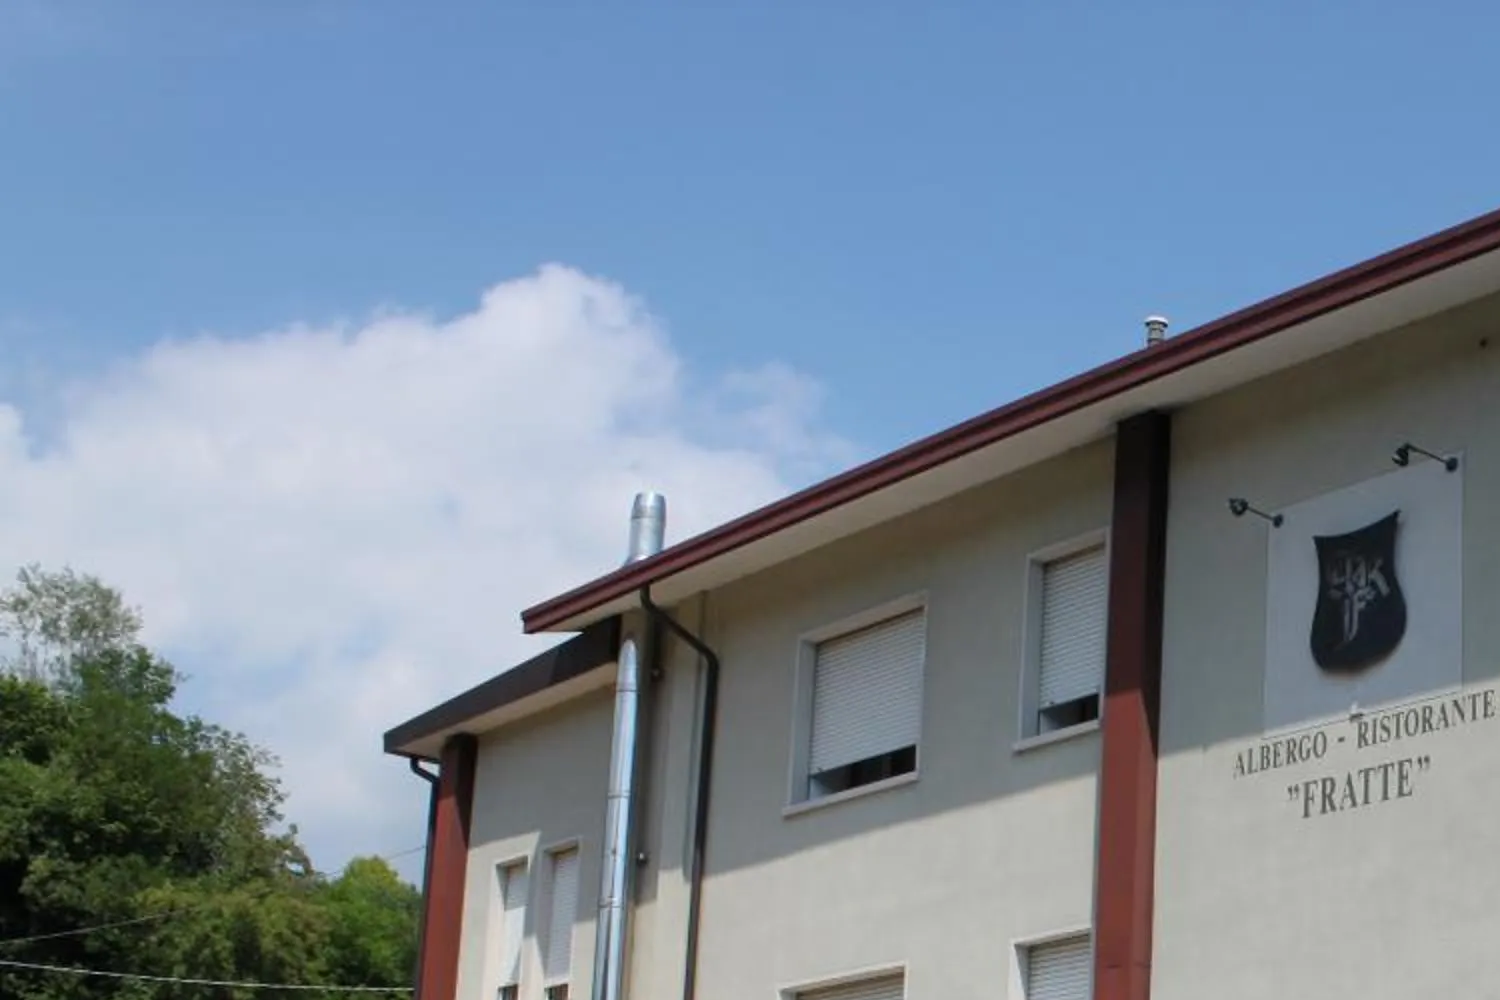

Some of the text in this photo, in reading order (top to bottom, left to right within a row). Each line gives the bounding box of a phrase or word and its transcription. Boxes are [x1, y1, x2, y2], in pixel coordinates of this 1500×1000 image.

[1234, 731, 1327, 778] ALBERGO
[1357, 690, 1496, 749] RISTORANTE
[1287, 755, 1431, 818] "FRATTE"
